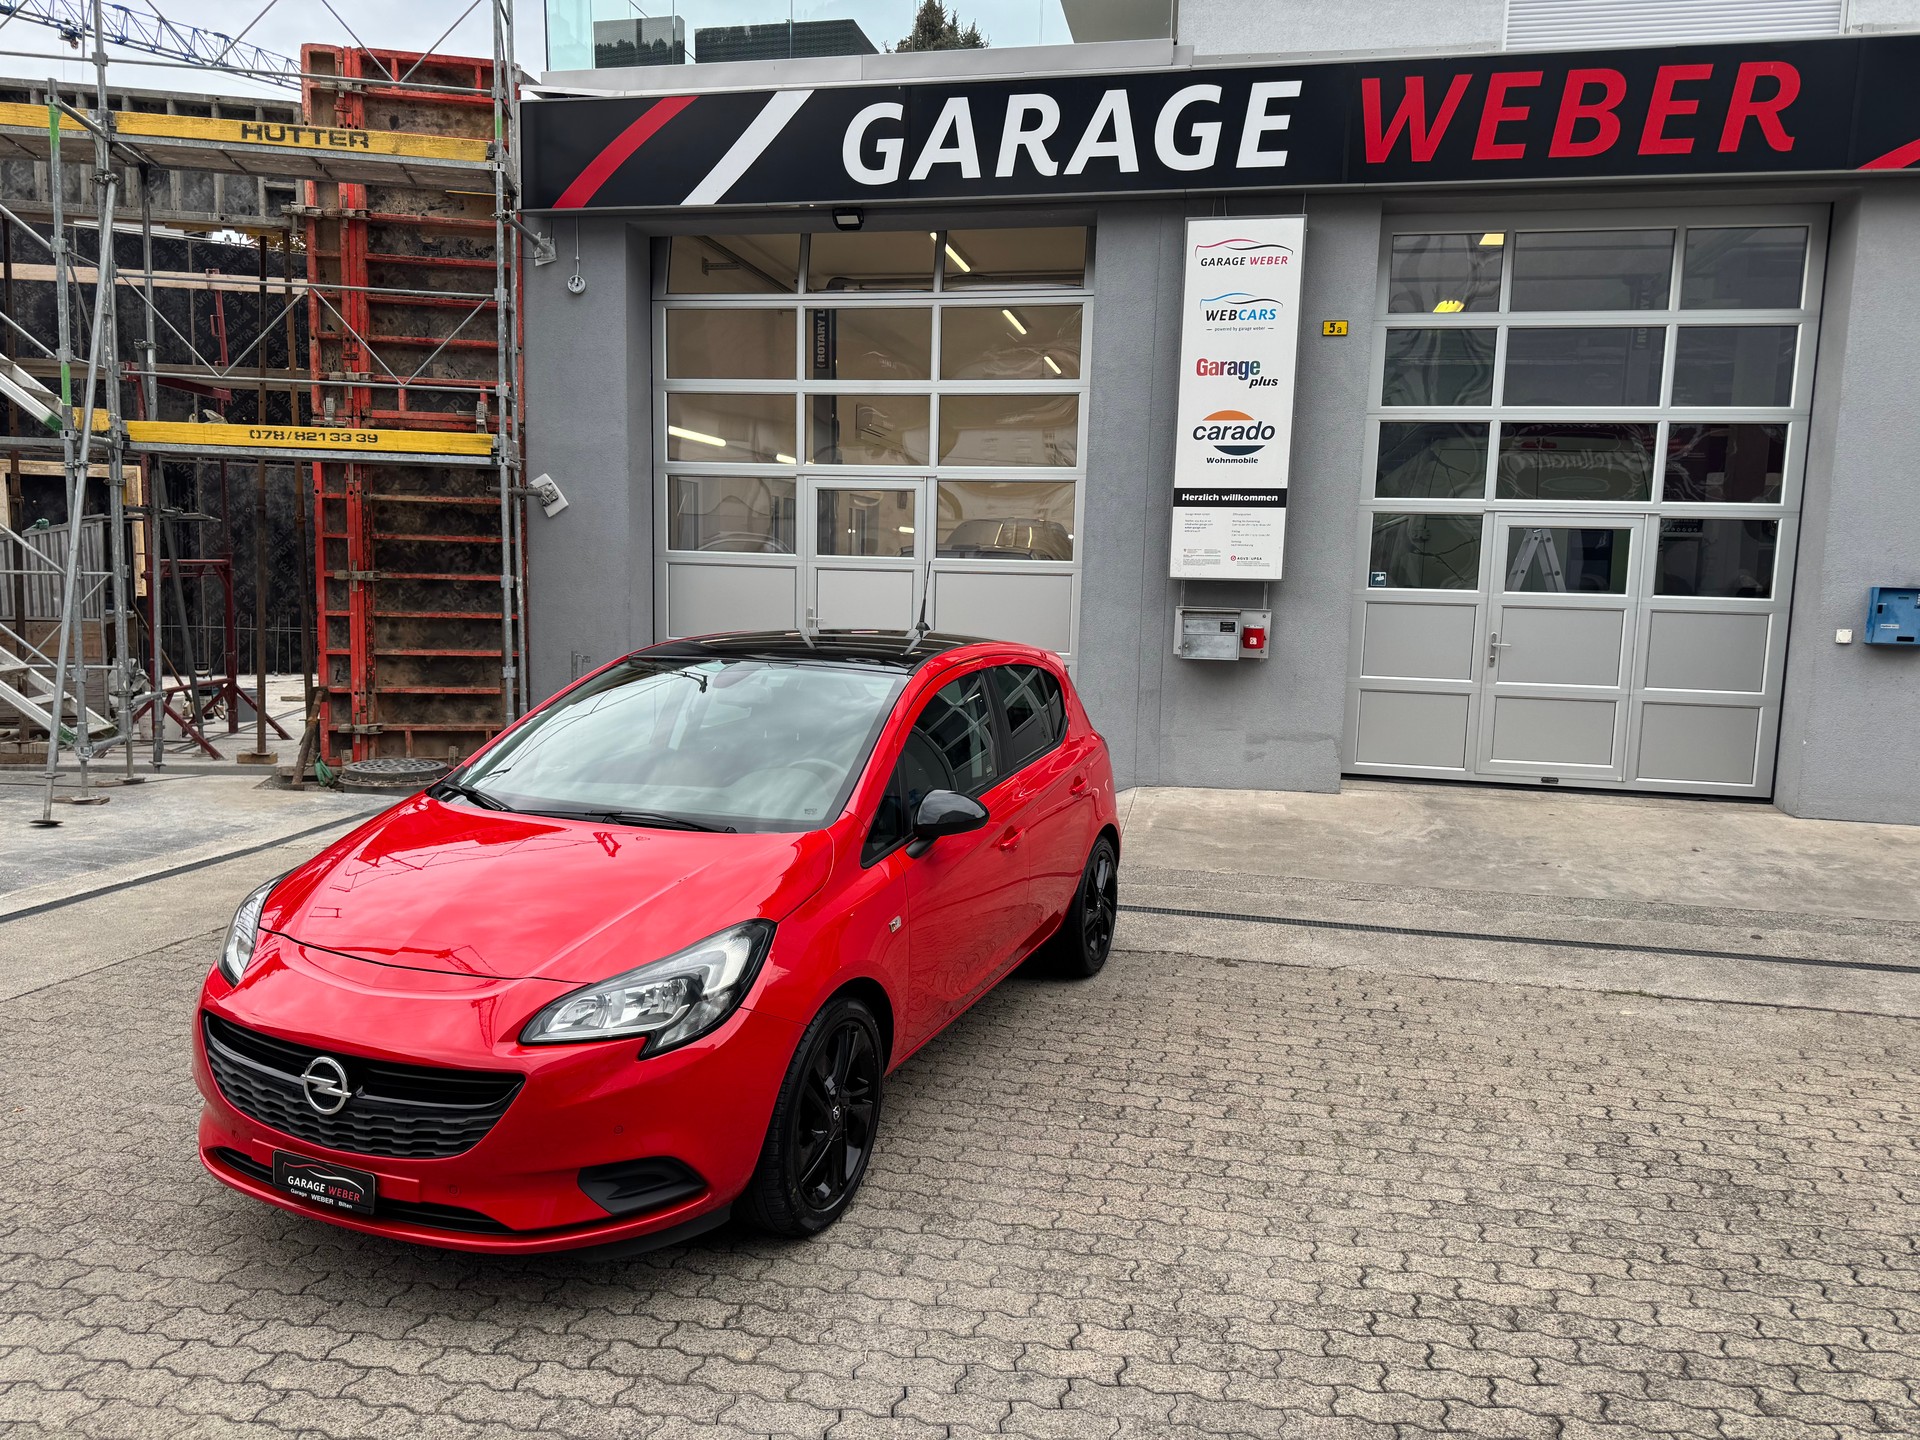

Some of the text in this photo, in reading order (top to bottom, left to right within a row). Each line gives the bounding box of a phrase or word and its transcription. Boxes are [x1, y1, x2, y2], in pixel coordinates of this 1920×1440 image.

[841, 60, 1801, 187] GARAGE WEBER
[241, 123, 369, 148] HUTTER
[1200, 256, 1288, 267] GARAGE WEBER
[1206, 308, 1277, 321] WEBCARS
[1196, 358, 1261, 381] Garage
[1248, 376, 1278, 389] plus
[1192, 421, 1275, 441] carado
[1181, 493, 1279, 502] Herzlich willkommen
[287, 1175, 361, 1203] GARAGE WEBER
[290, 1188, 353, 1209] Garage WEBER Bilten
